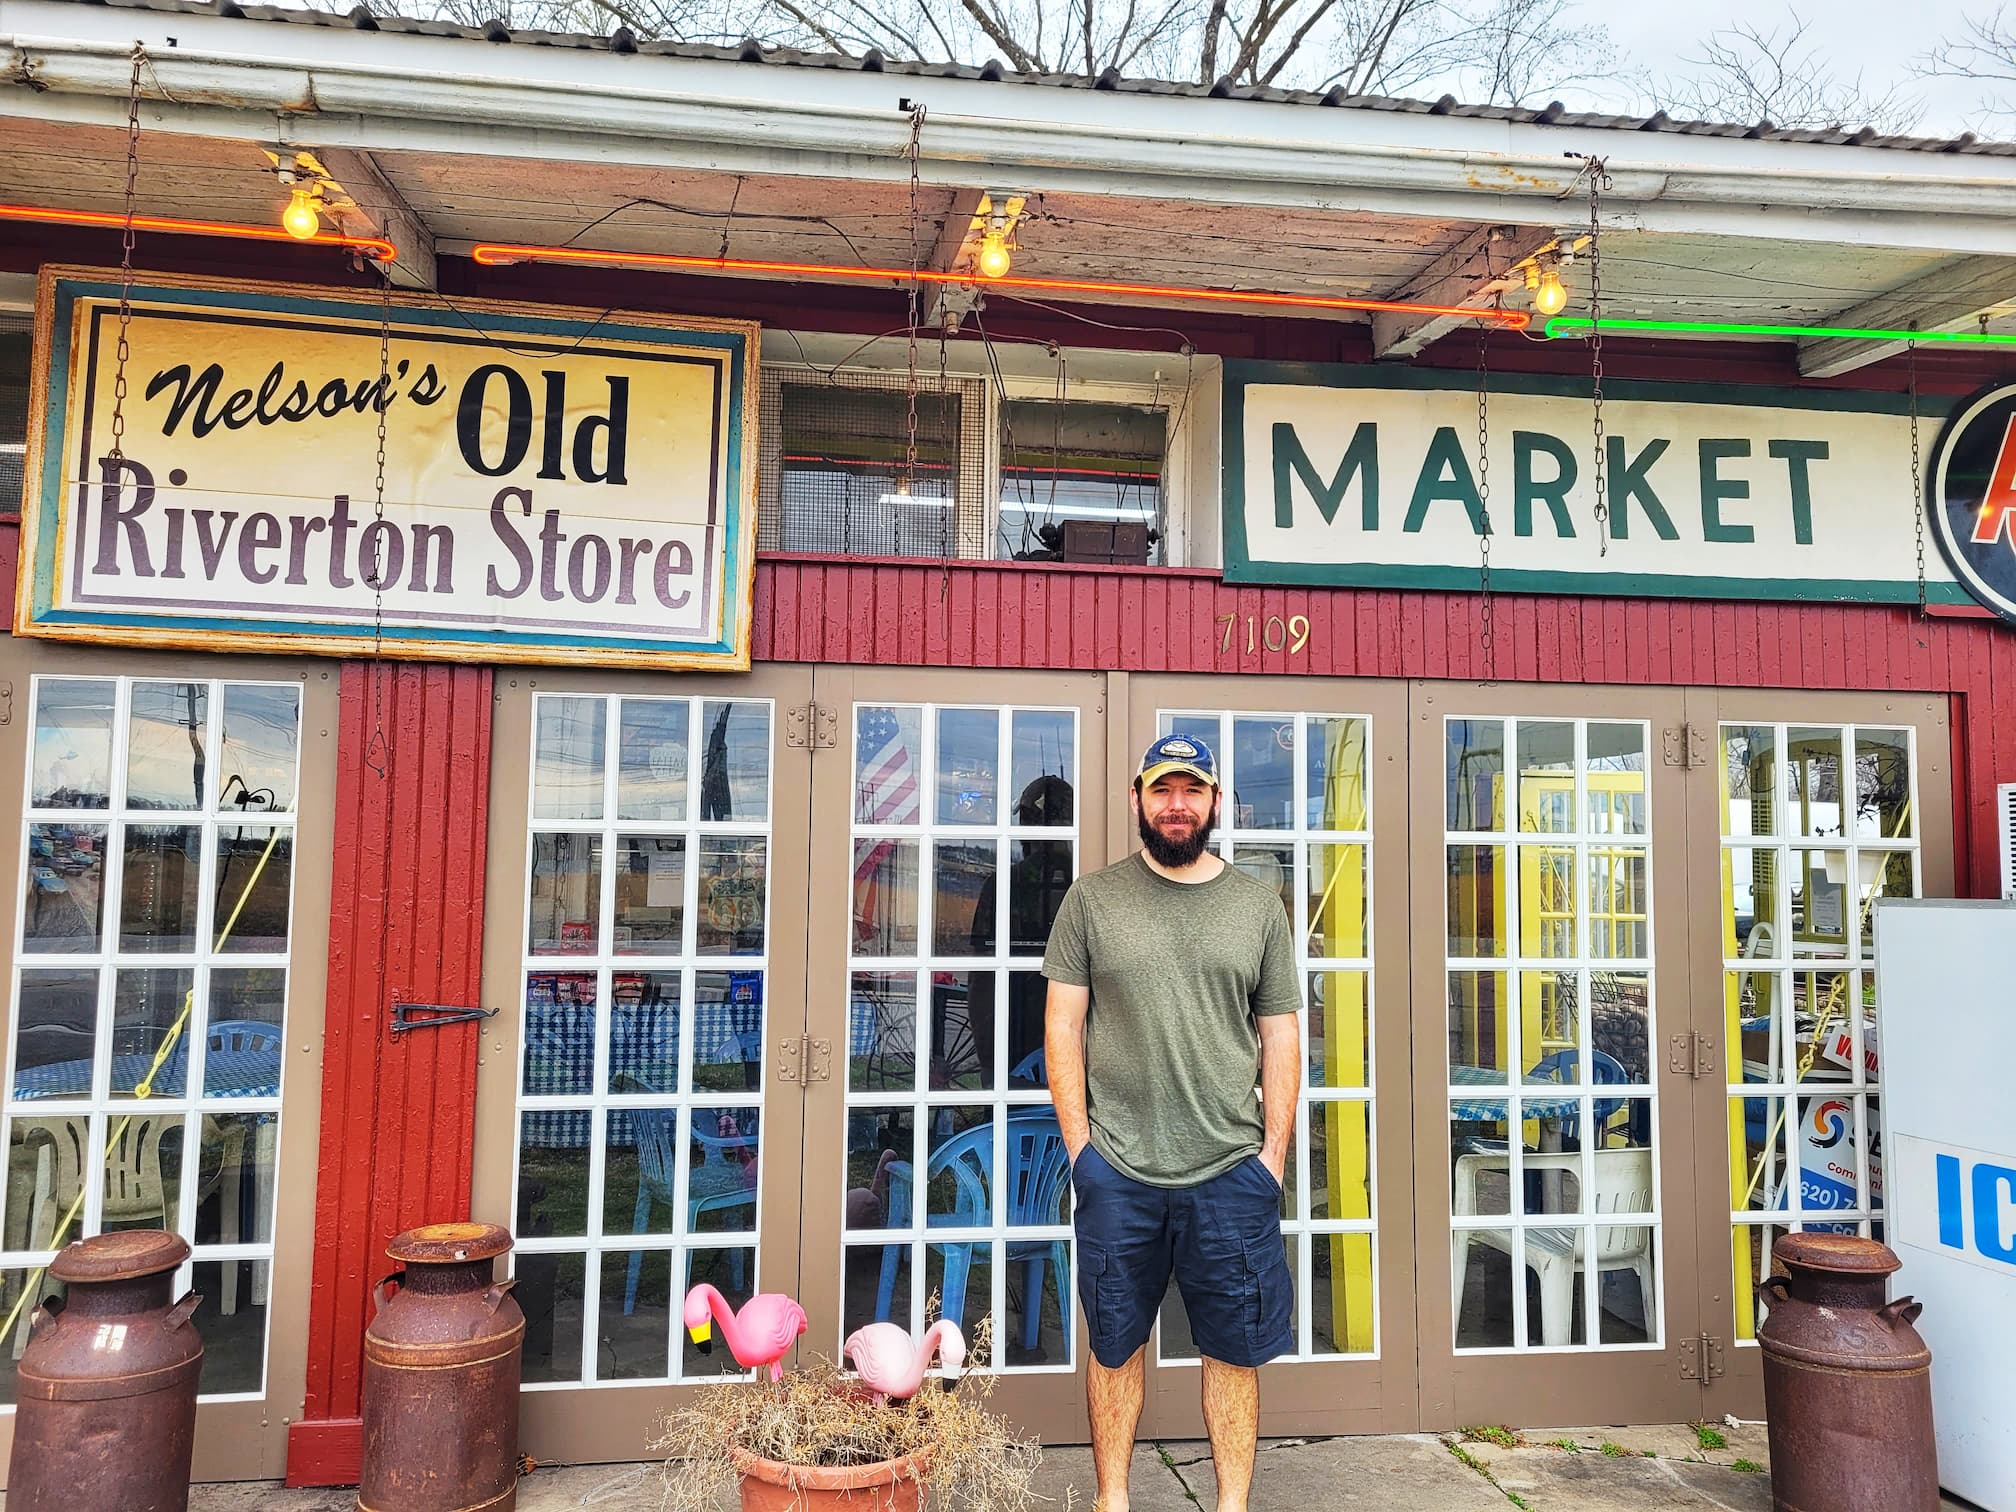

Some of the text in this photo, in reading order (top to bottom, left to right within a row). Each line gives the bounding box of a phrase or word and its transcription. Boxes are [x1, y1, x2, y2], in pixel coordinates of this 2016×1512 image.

[145, 359, 630, 486] Nelson's Old
[1271, 421, 1830, 546] MARKET
[92, 456, 696, 610] Riverton Store
[1216, 612, 1310, 655] 7109
